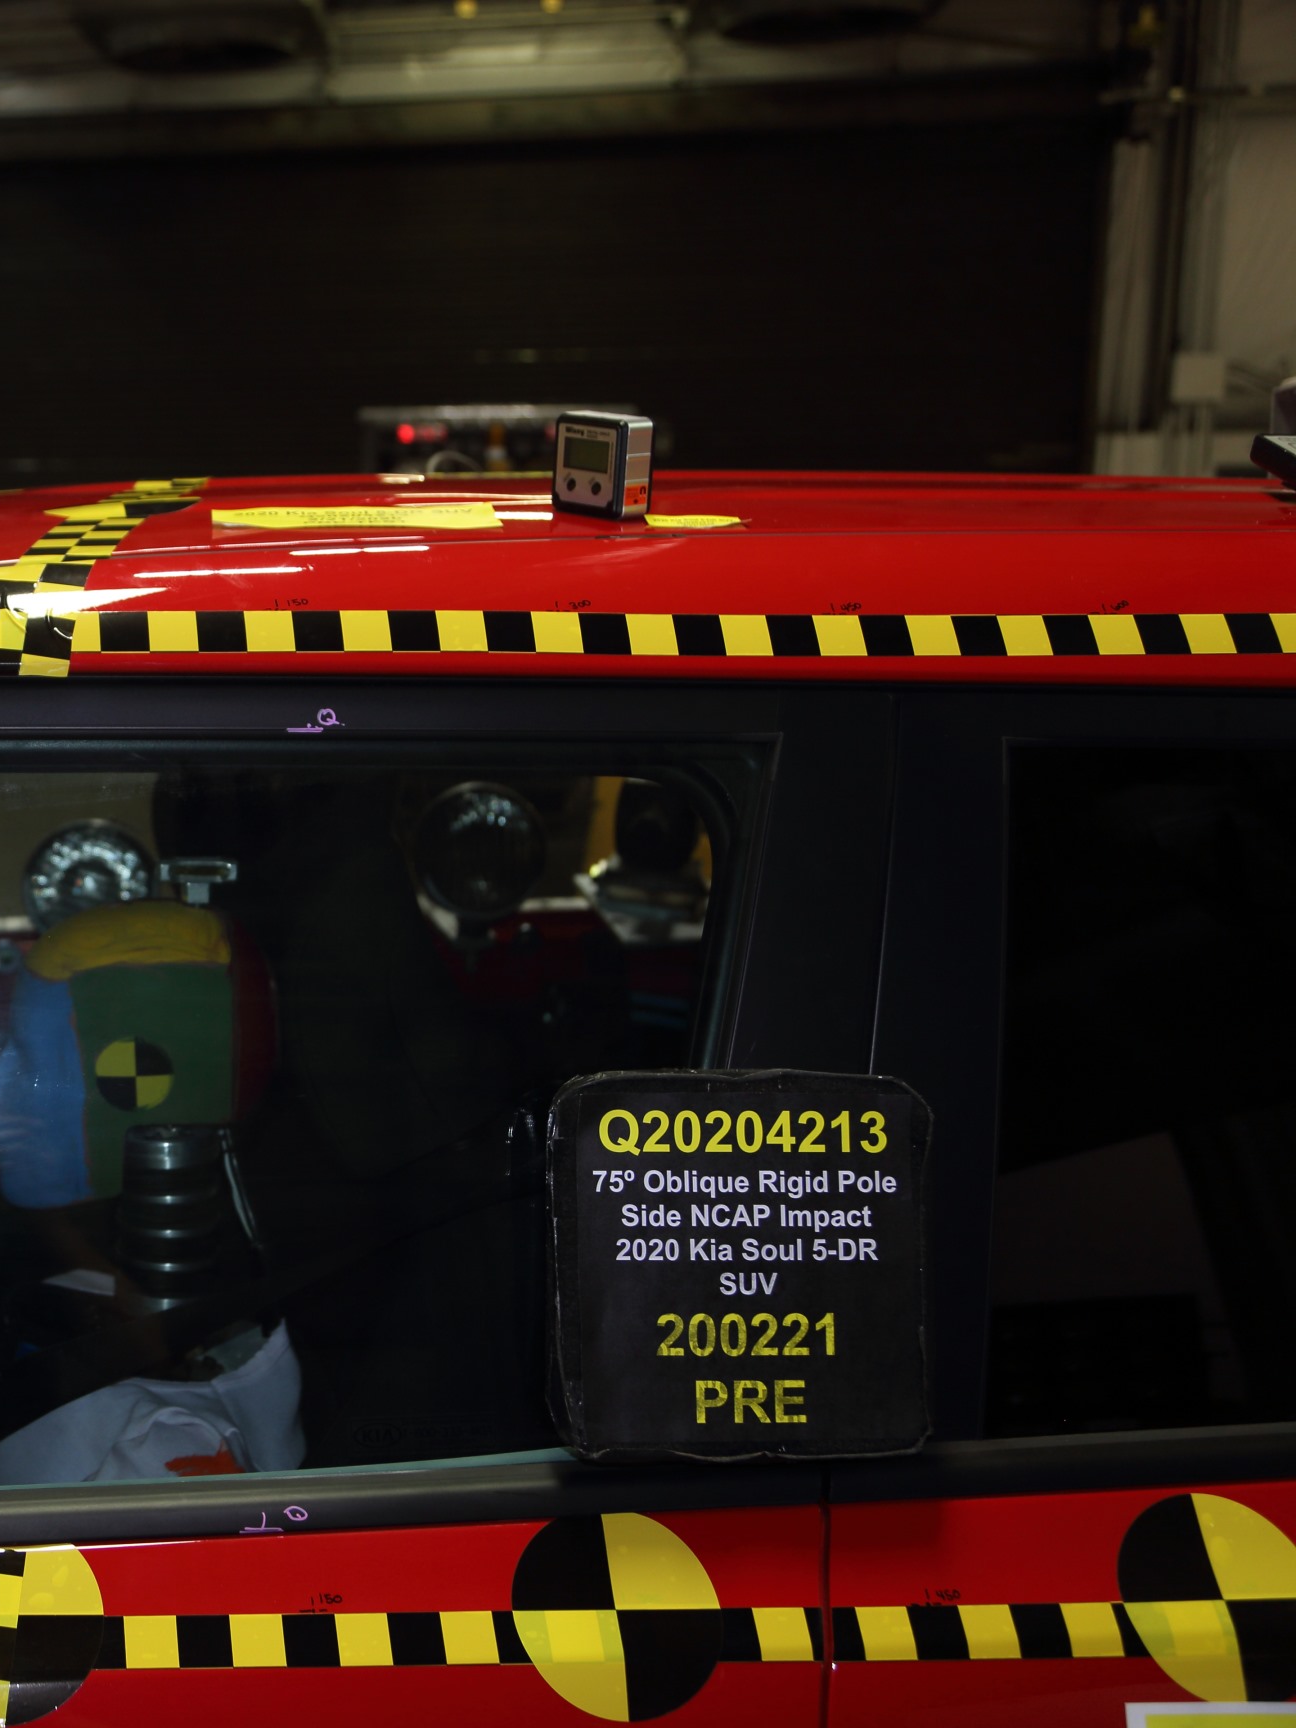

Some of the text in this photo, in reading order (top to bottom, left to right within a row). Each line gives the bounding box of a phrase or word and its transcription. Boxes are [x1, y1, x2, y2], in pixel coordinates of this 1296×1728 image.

[599, 1109, 887, 1156] Q20204213
[644, 1170, 749, 1198] Oblique
[759, 1170, 828, 1198] Rigid
[838, 1170, 897, 1193] Pole
[621, 1204, 872, 1232] Side NCAP Impact
[616, 1238, 878, 1261] 2020 Kia Soul 5-DR
[720, 1272, 777, 1295] SUV
[657, 1313, 836, 1356] 200221
[695, 1380, 807, 1424] PRE
